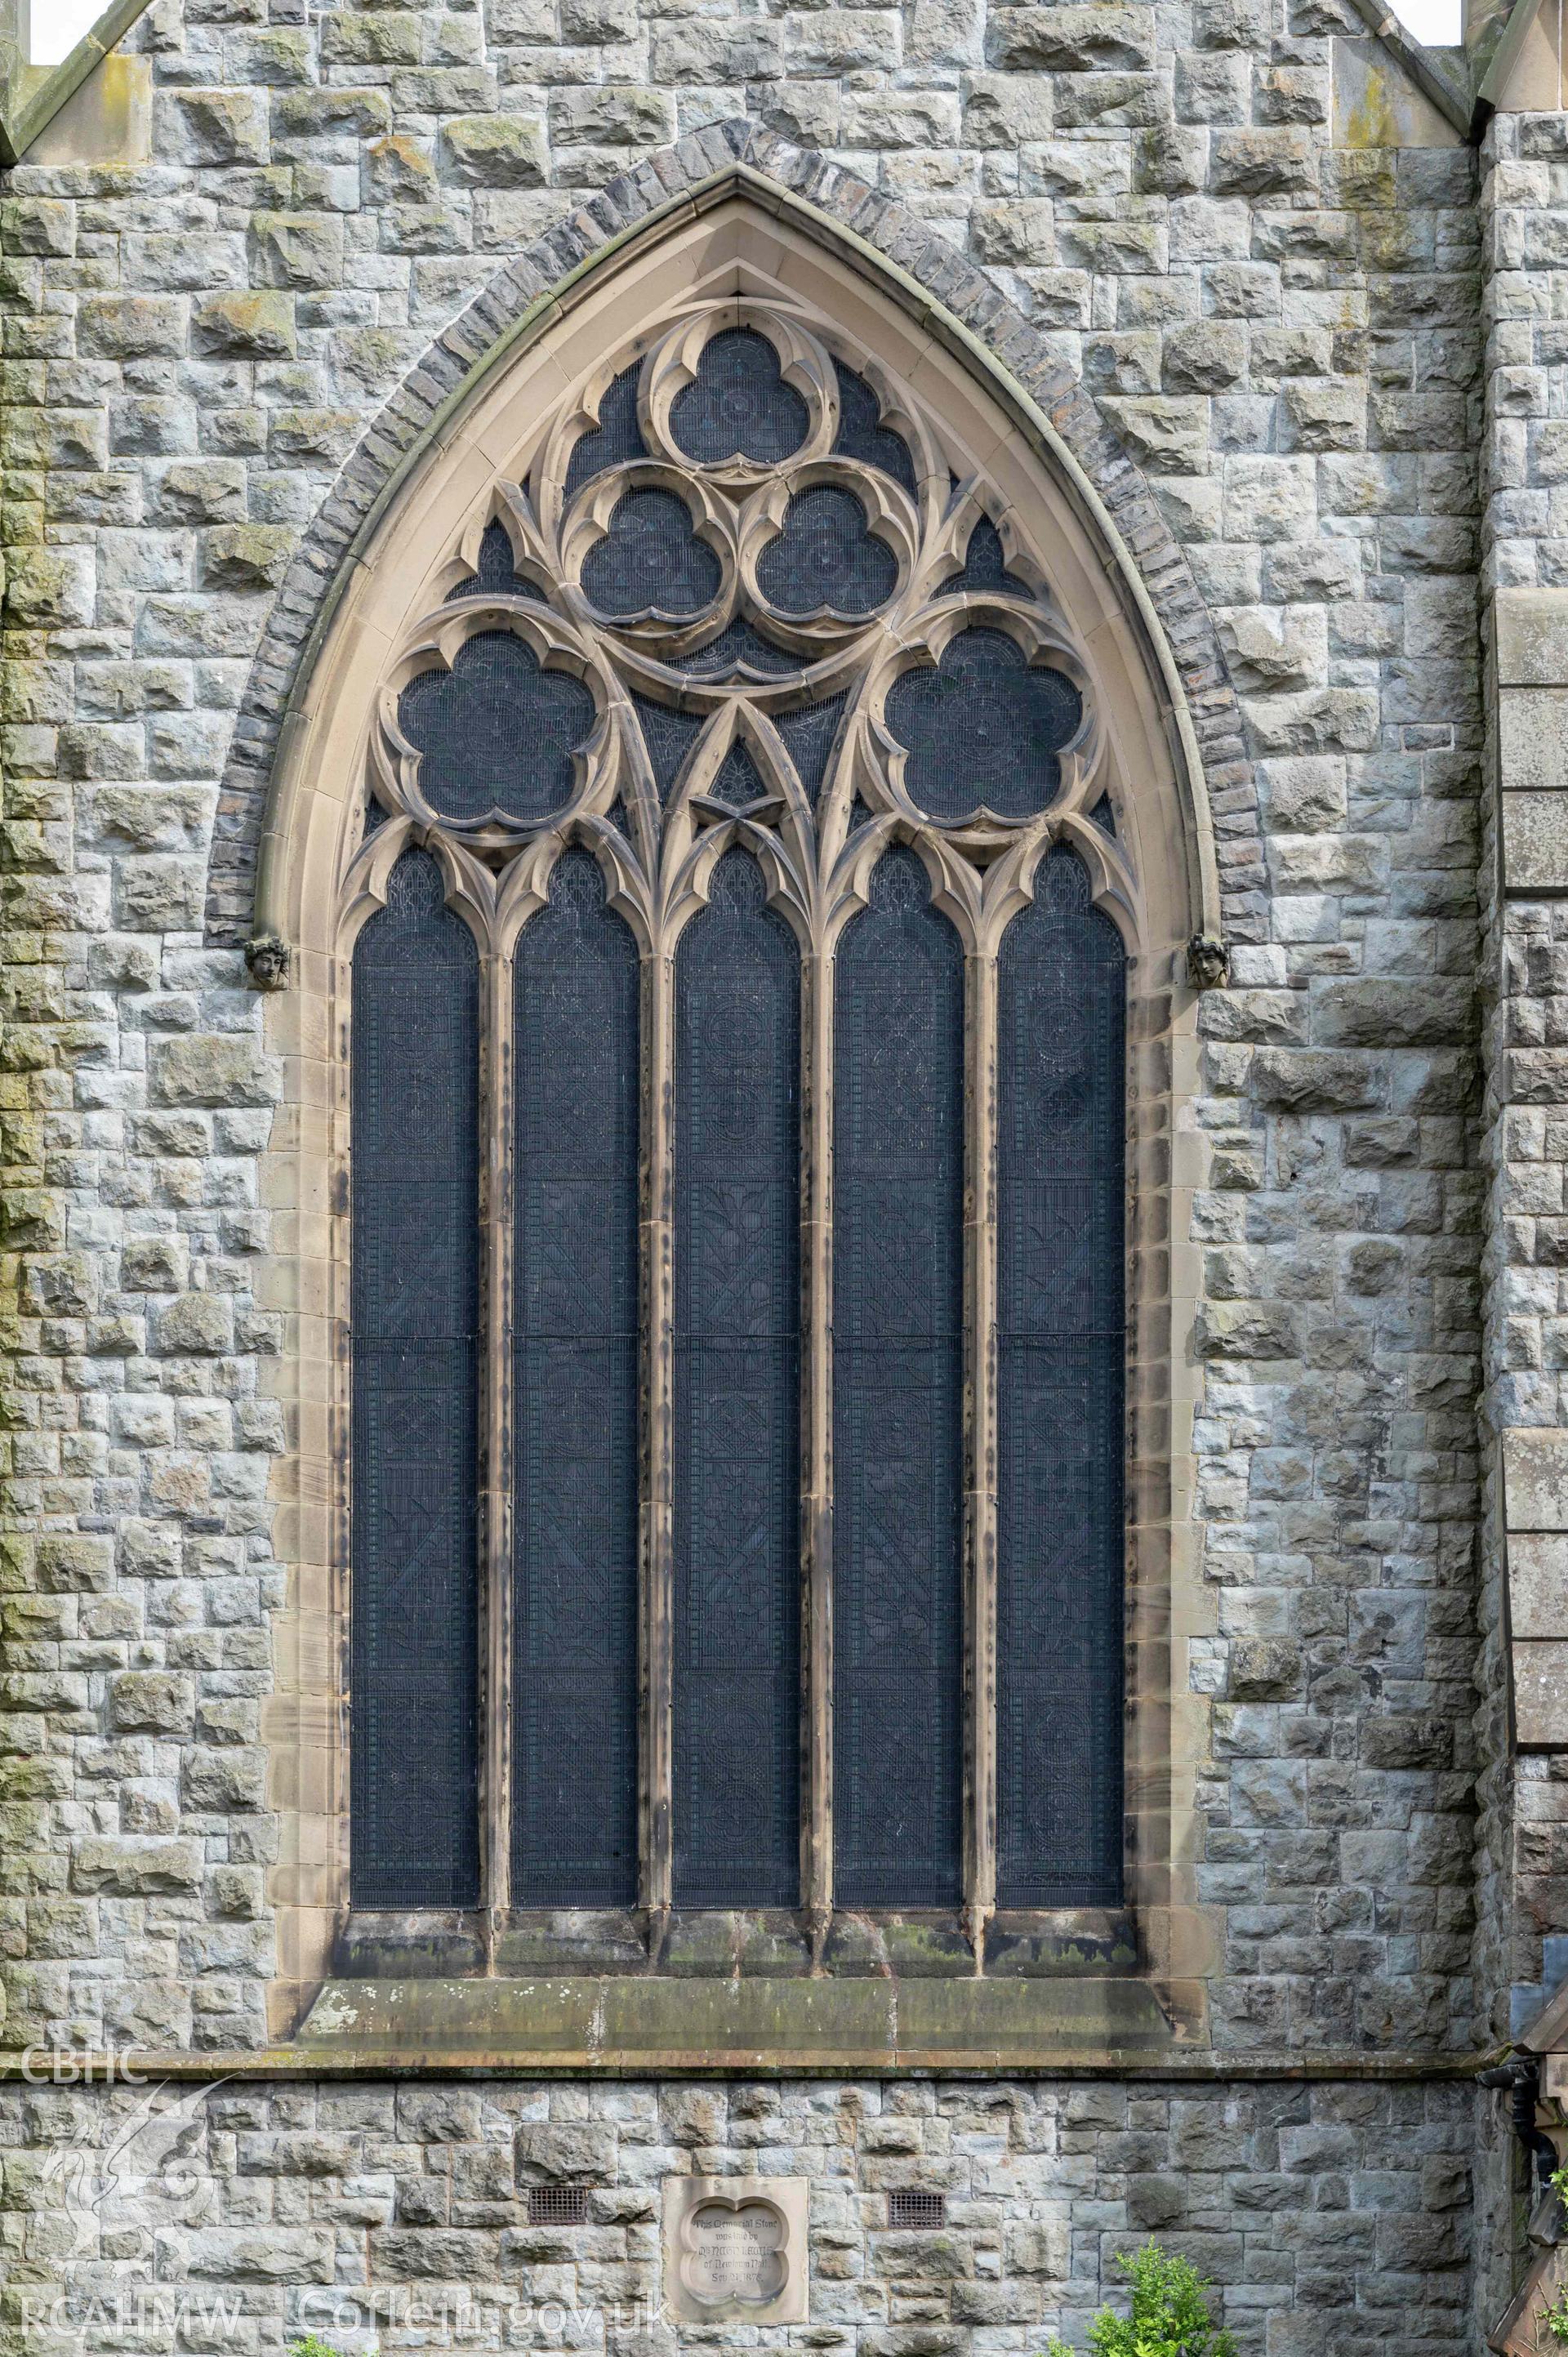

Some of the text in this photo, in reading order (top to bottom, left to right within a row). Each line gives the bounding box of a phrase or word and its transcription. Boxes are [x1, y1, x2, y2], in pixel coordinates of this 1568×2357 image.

[755, 2219, 777, 2228] Stone
[749, 2231, 759, 2240] by
[704, 2260, 713, 2269] of
